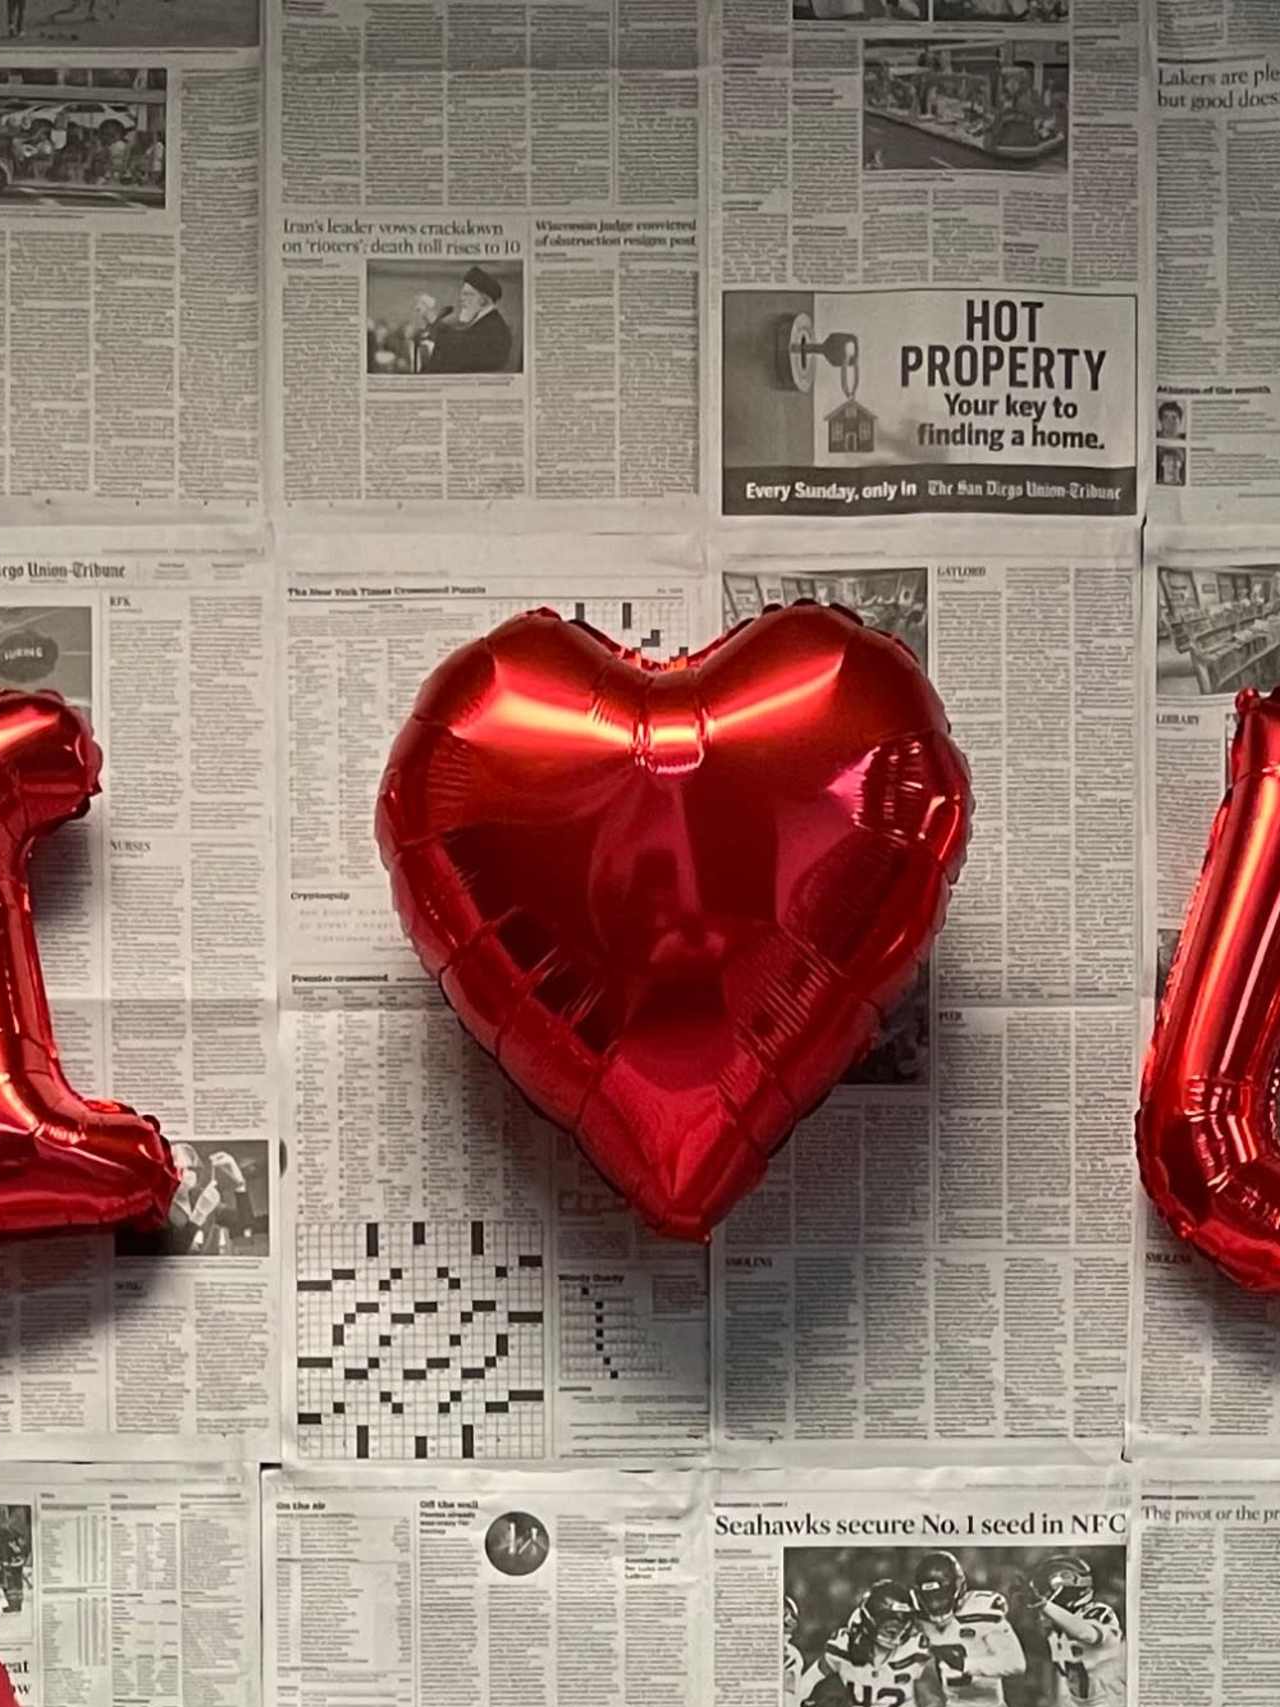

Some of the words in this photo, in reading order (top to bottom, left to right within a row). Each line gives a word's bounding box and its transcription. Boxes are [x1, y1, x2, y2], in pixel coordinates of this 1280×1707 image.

[966, 299, 1044, 342] HOT
[901, 346, 1106, 391] PROPERTY
[944, 395, 999, 416] Your
[1006, 395, 1047, 422] key
[1053, 396, 1078, 419] to
[918, 424, 1005, 452] finding
[1011, 430, 1024, 446] a
[1032, 424, 1105, 450] home.
[746, 482, 791, 502] Every
[795, 481, 859, 503] Sunday,
[862, 481, 898, 501] only
[901, 480, 917, 495] in
[715, 1514, 831, 1535] Seahawks
[837, 1520, 915, 1534] secure
[922, 1514, 959, 1534] No.
[967, 1515, 974, 1534] 1
[982, 1514, 1034, 1534] seed
[1042, 1514, 1063, 1534] in
[1072, 1514, 1125, 1533] NFC
